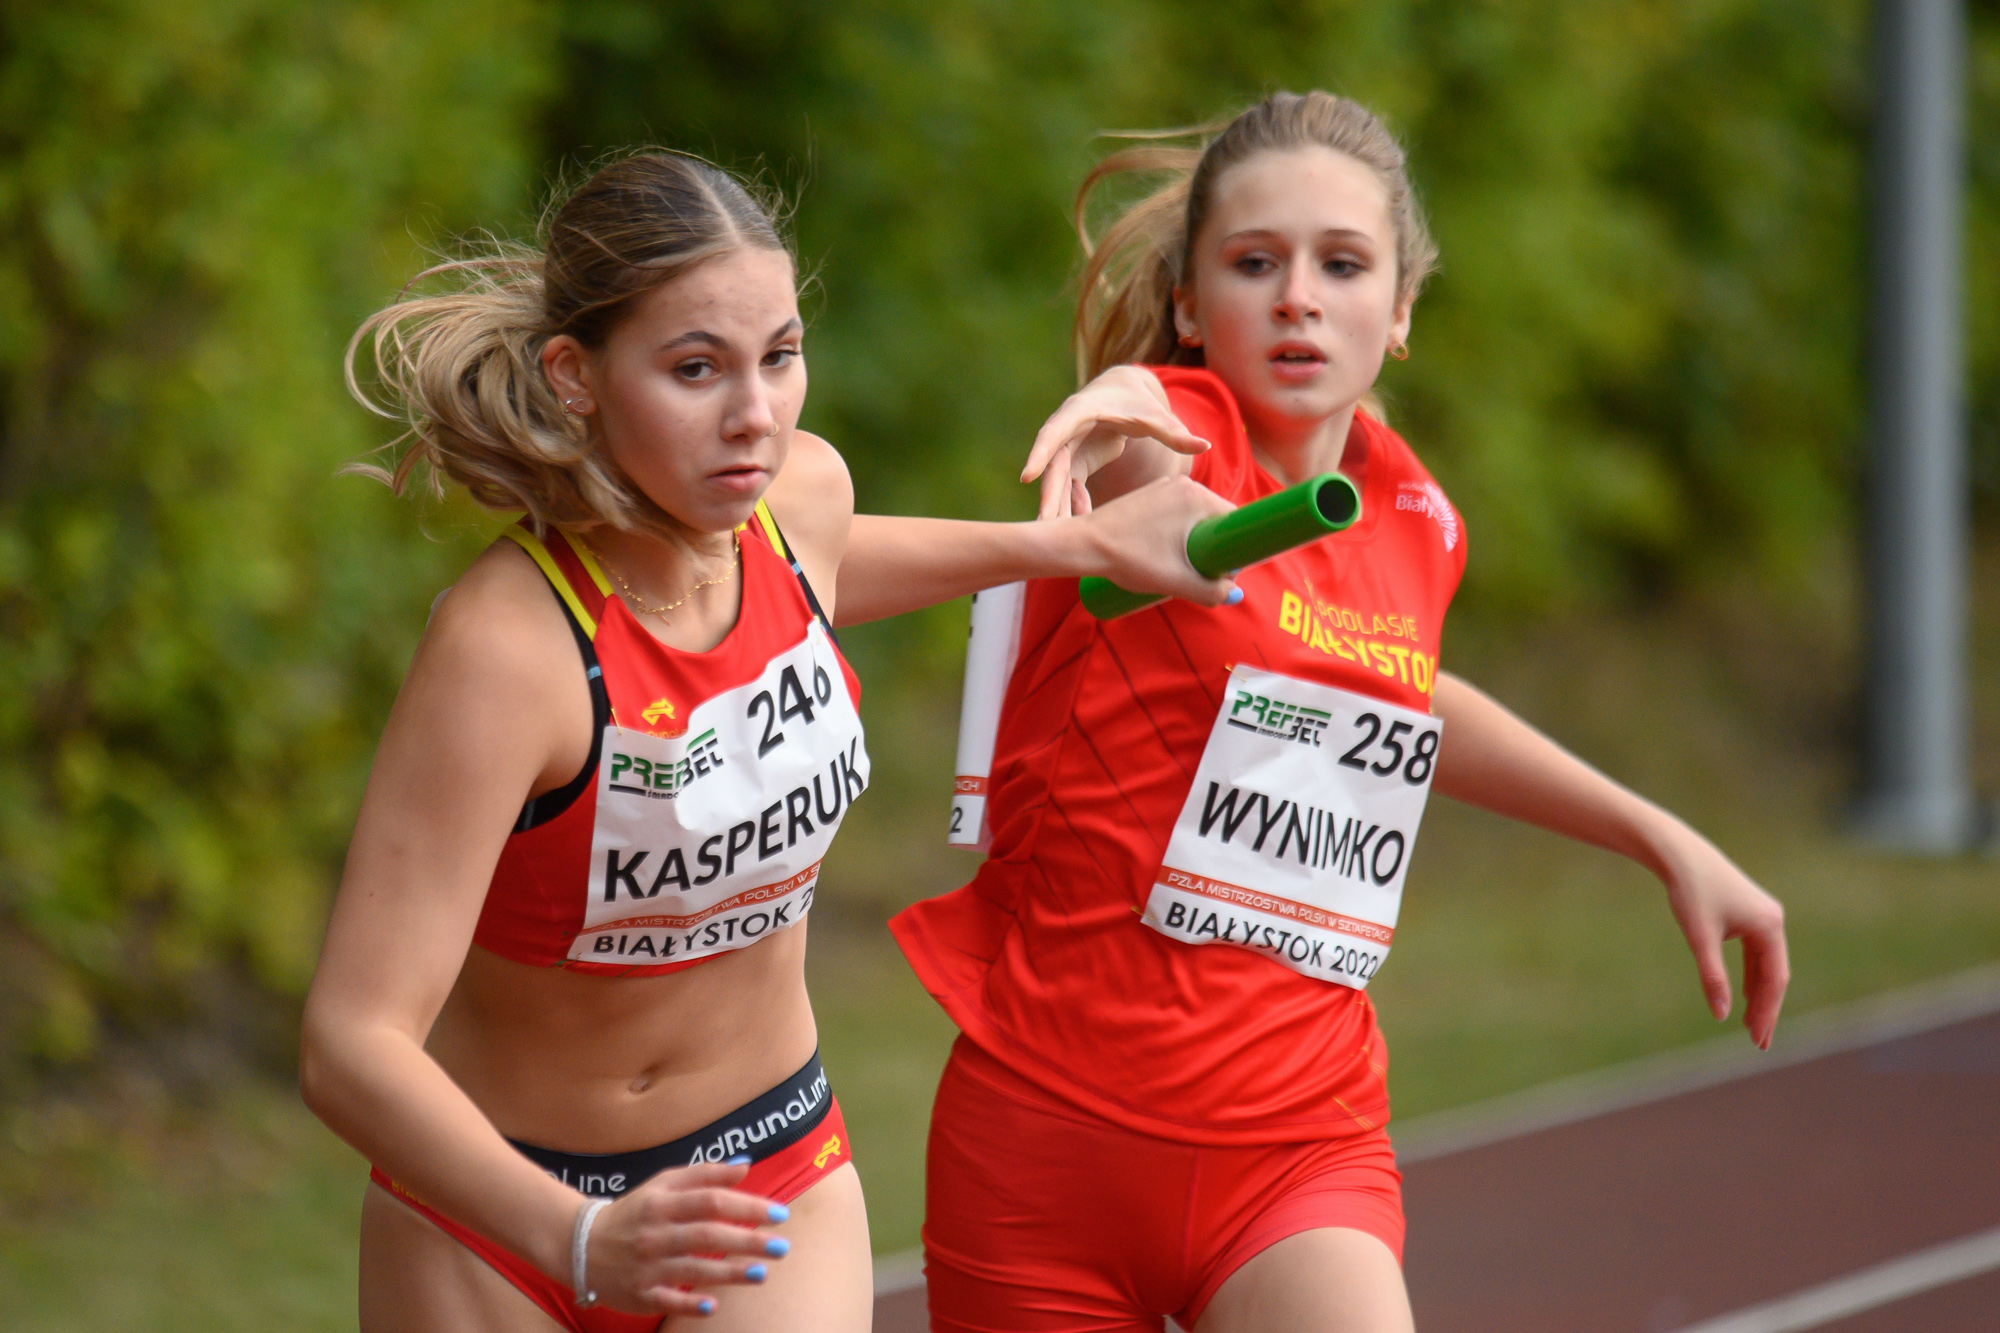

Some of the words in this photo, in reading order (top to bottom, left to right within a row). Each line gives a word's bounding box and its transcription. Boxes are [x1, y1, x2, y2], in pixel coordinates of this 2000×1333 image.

[746, 641, 832, 760] 246
[1337, 712, 1439, 787] 258
[604, 736, 864, 903] KASPERUK
[1198, 781, 1405, 888] WYNIMKO
[593, 901, 793, 958] BIAŁYSTOK
[634, 897, 741, 926] MISTRZOSTWA
[744, 880, 794, 903] POLSKI
[797, 871, 809, 884] W
[1167, 872, 1204, 892] PZLA
[1206, 884, 1297, 916] MISTRZOSTWA
[1298, 908, 1326, 925] POLSKI
[1328, 916, 1338, 928] W
[1338, 919, 1391, 942] SZTAFETACH
[1165, 901, 1325, 968] BIAŁYSTOK
[1329, 945, 1377, 981] 2022
